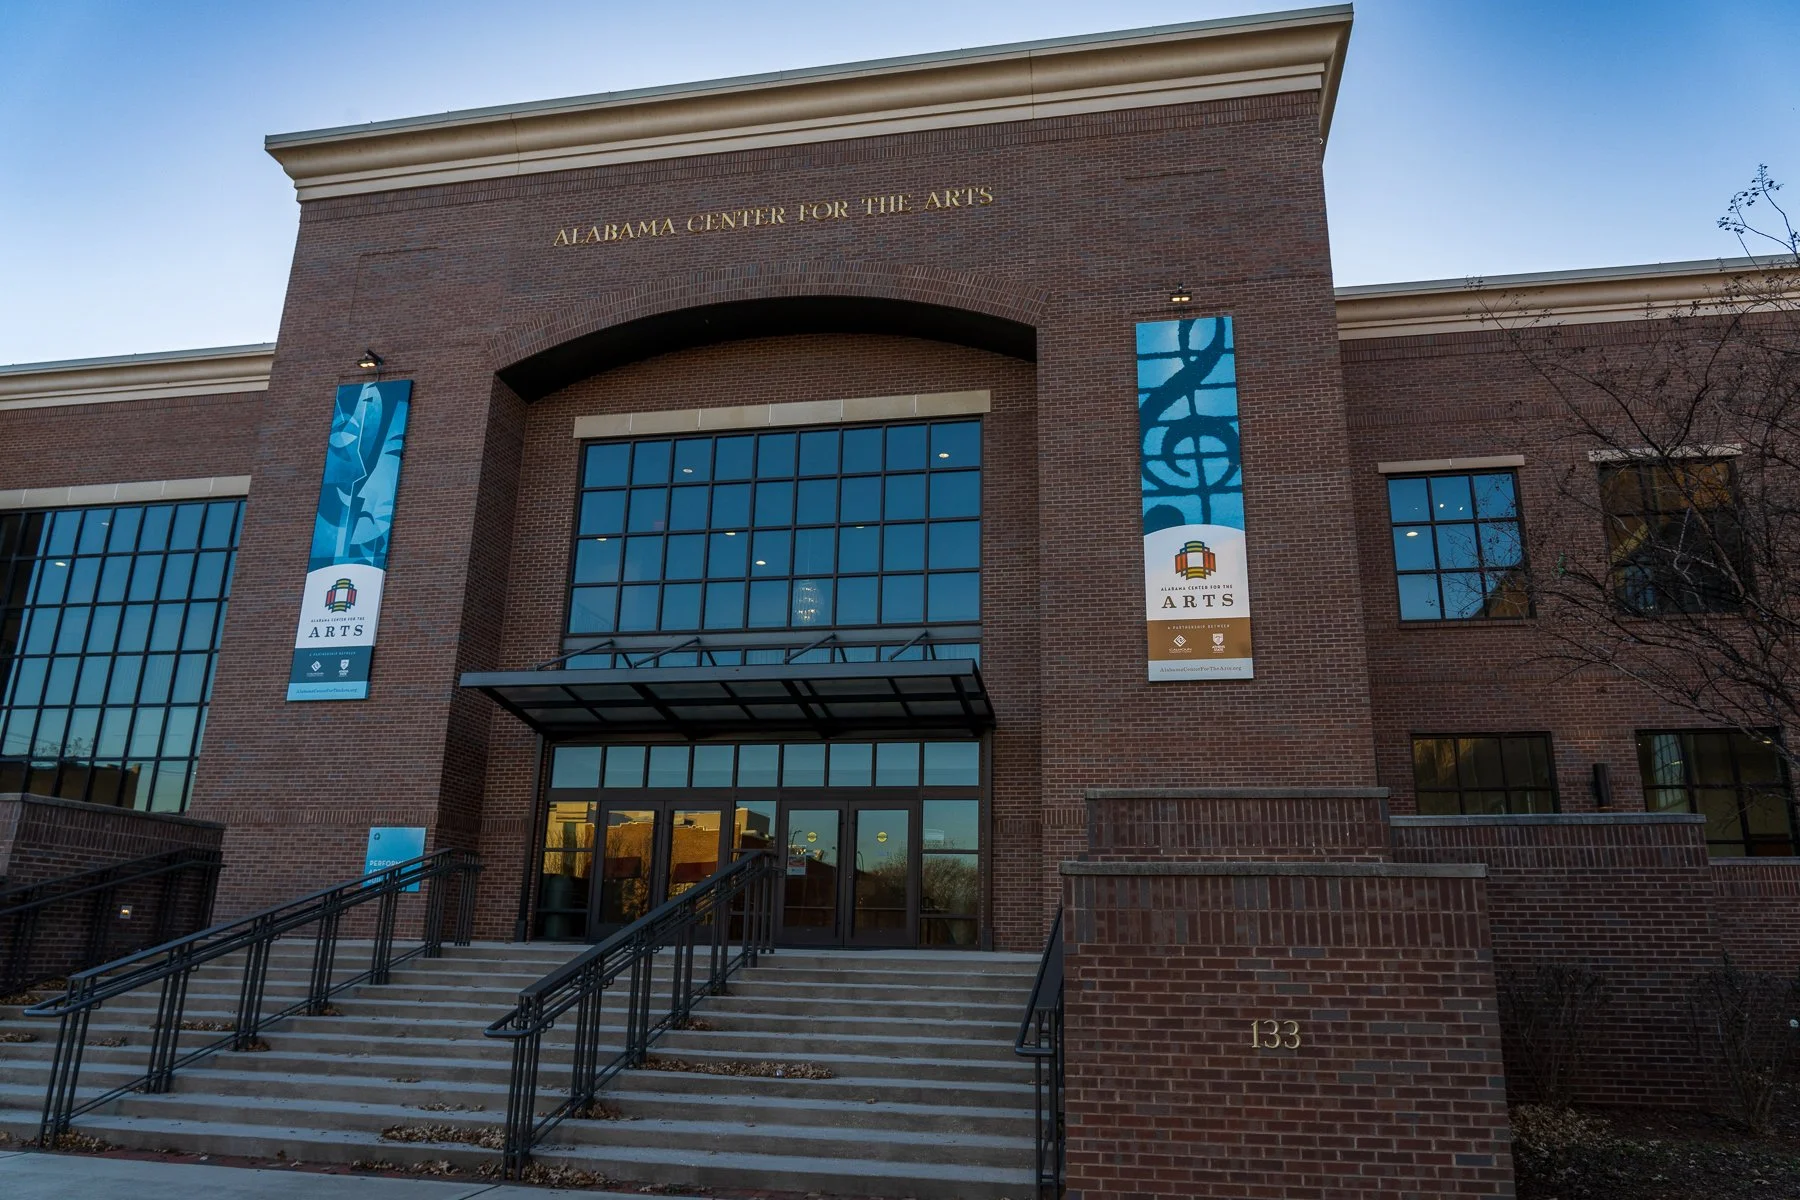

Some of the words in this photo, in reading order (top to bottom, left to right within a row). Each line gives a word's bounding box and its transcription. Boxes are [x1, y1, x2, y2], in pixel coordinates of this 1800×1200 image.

[553, 217, 676, 247] ALABAMA
[687, 206, 787, 234] CENTER
[799, 200, 849, 222] FOR
[861, 192, 913, 216] THE
[924, 186, 994, 211] ARTS
[1161, 593, 1234, 608] ARTS
[308, 624, 364, 638] ARTS
[1251, 1019, 1302, 1049] 133
